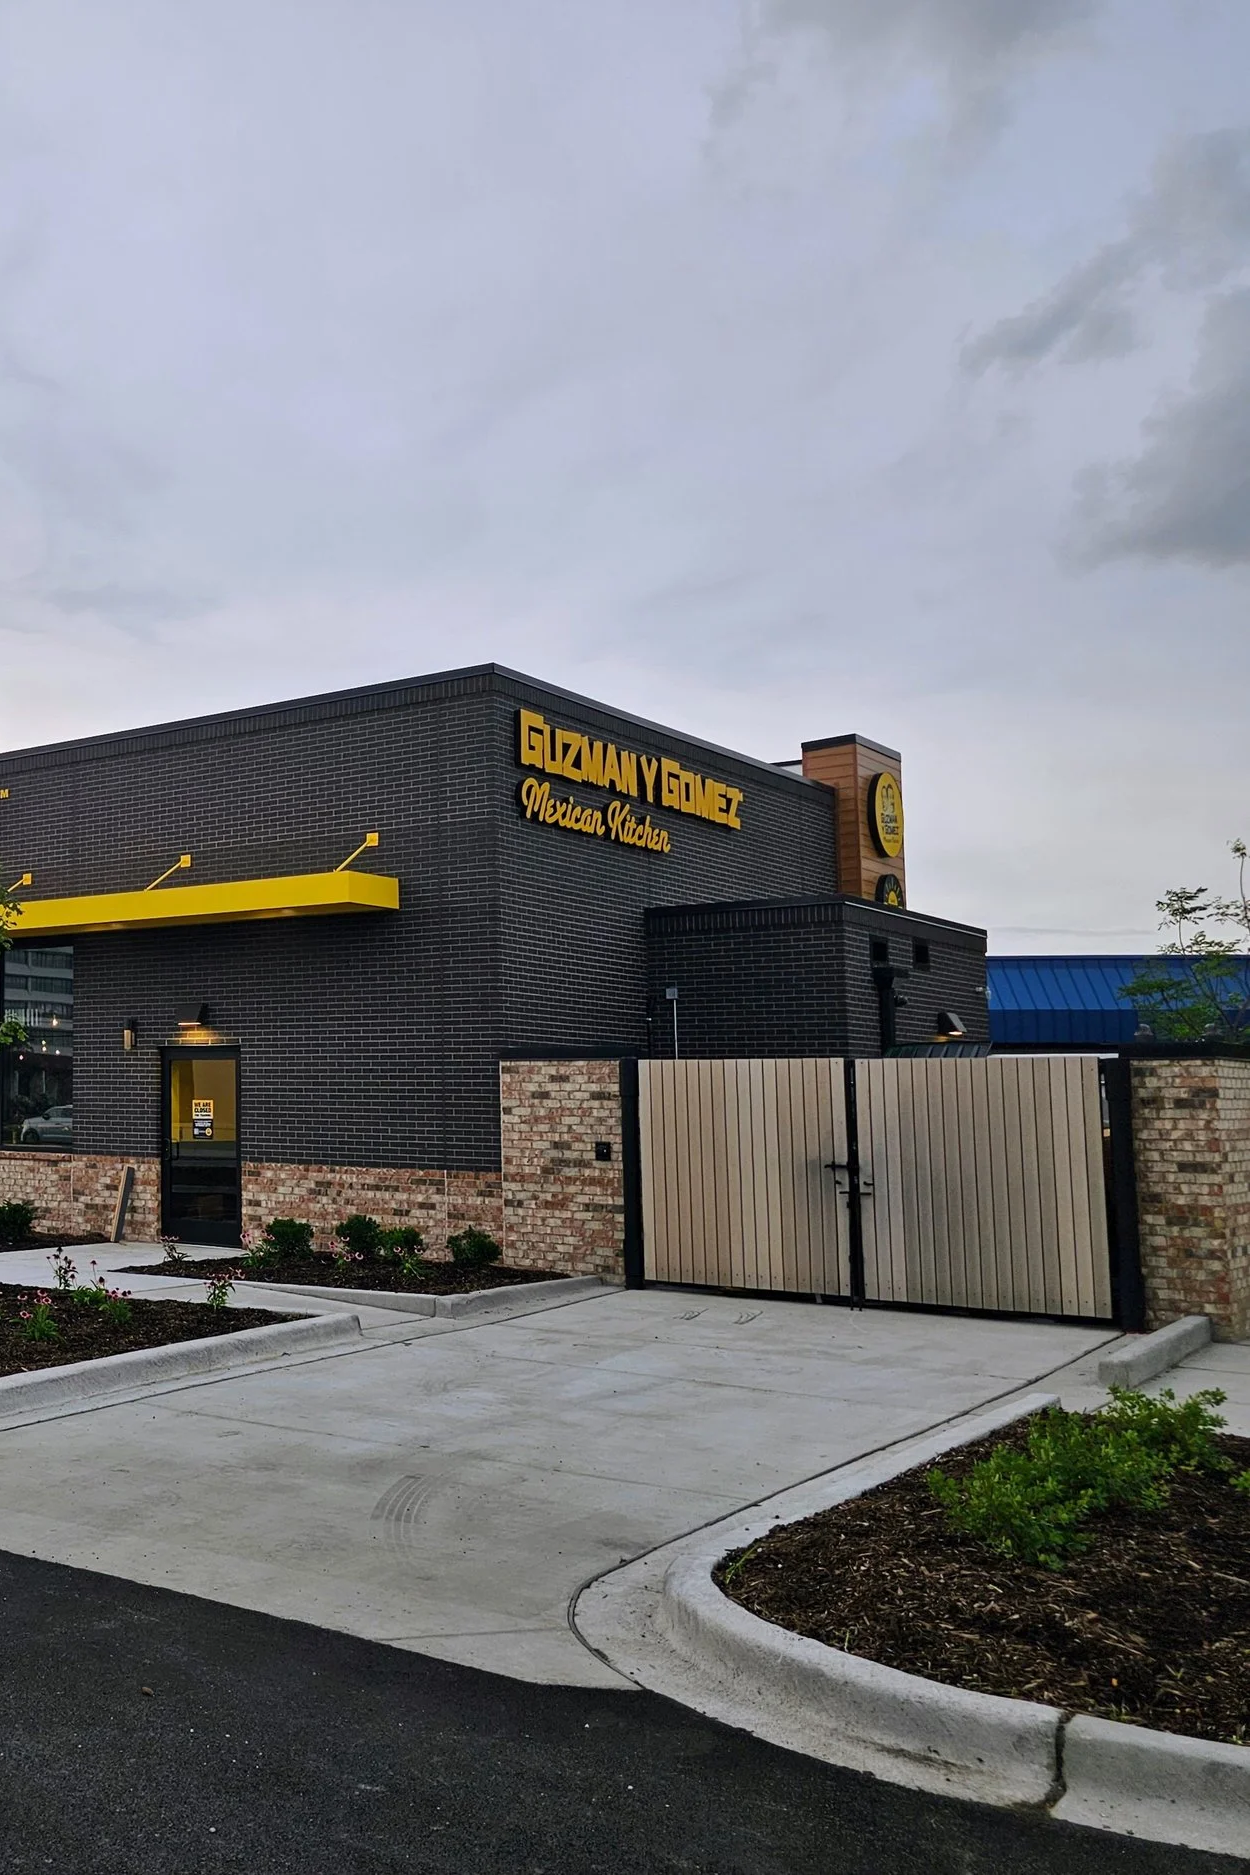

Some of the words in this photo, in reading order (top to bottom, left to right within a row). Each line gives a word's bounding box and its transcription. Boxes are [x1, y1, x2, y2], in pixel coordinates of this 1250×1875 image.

[520, 708, 637, 797] GUZMAN
[640, 754, 658, 803] Y
[661, 757, 743, 830] GOMEZ
[521, 777, 605, 836] Mexican
[607, 800, 671, 853] Kitchen
